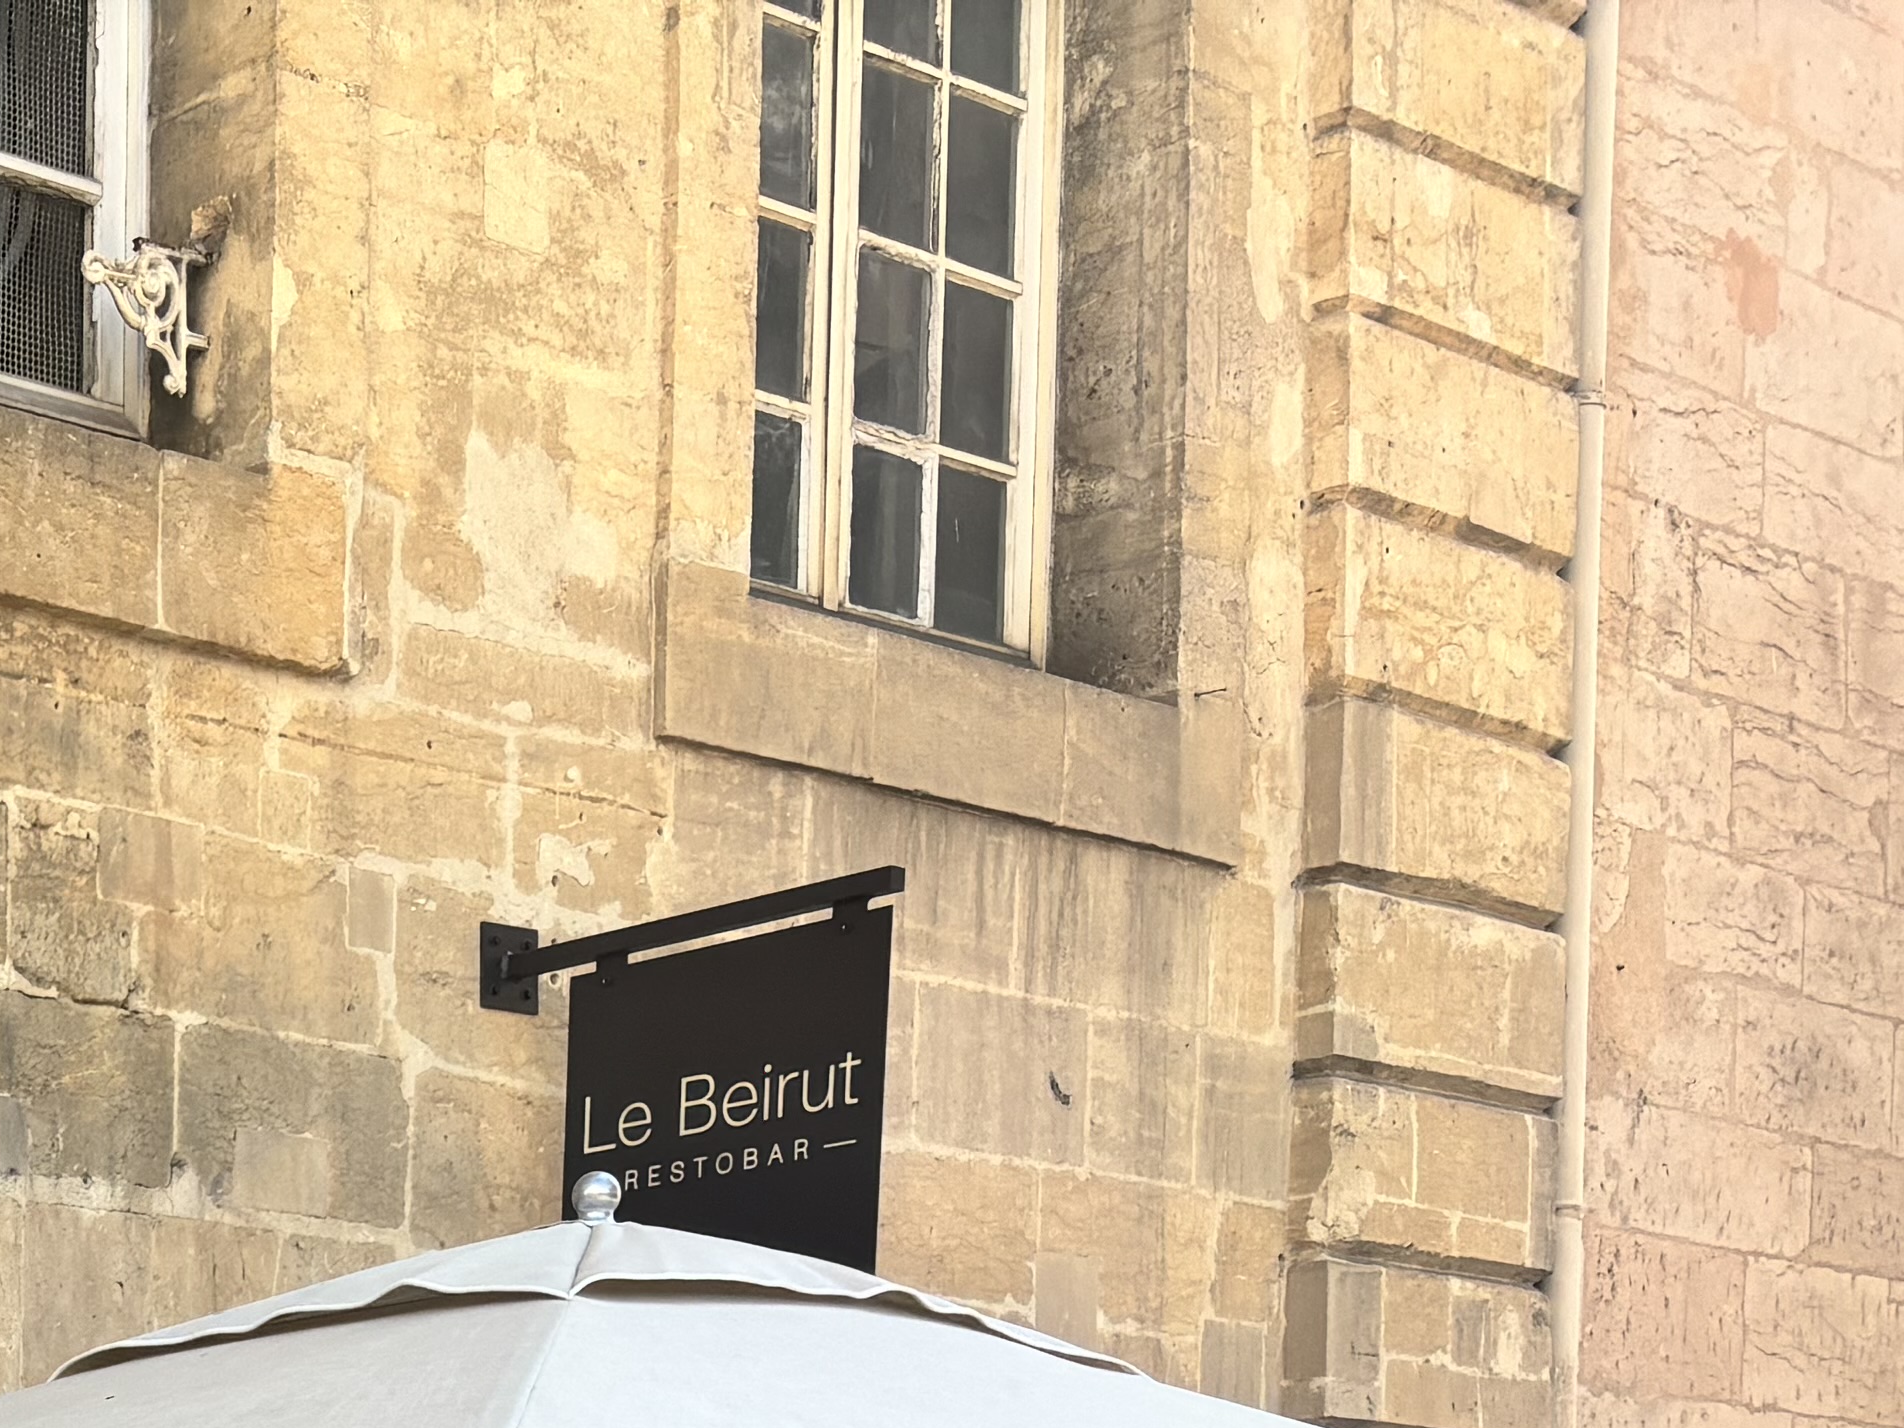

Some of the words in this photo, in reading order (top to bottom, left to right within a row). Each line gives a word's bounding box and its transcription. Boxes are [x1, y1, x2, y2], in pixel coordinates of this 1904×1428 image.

[583, 1095, 652, 1155] Le
[678, 1051, 862, 1137] Beirut
[624, 1138, 809, 1192] RESTOBAR
